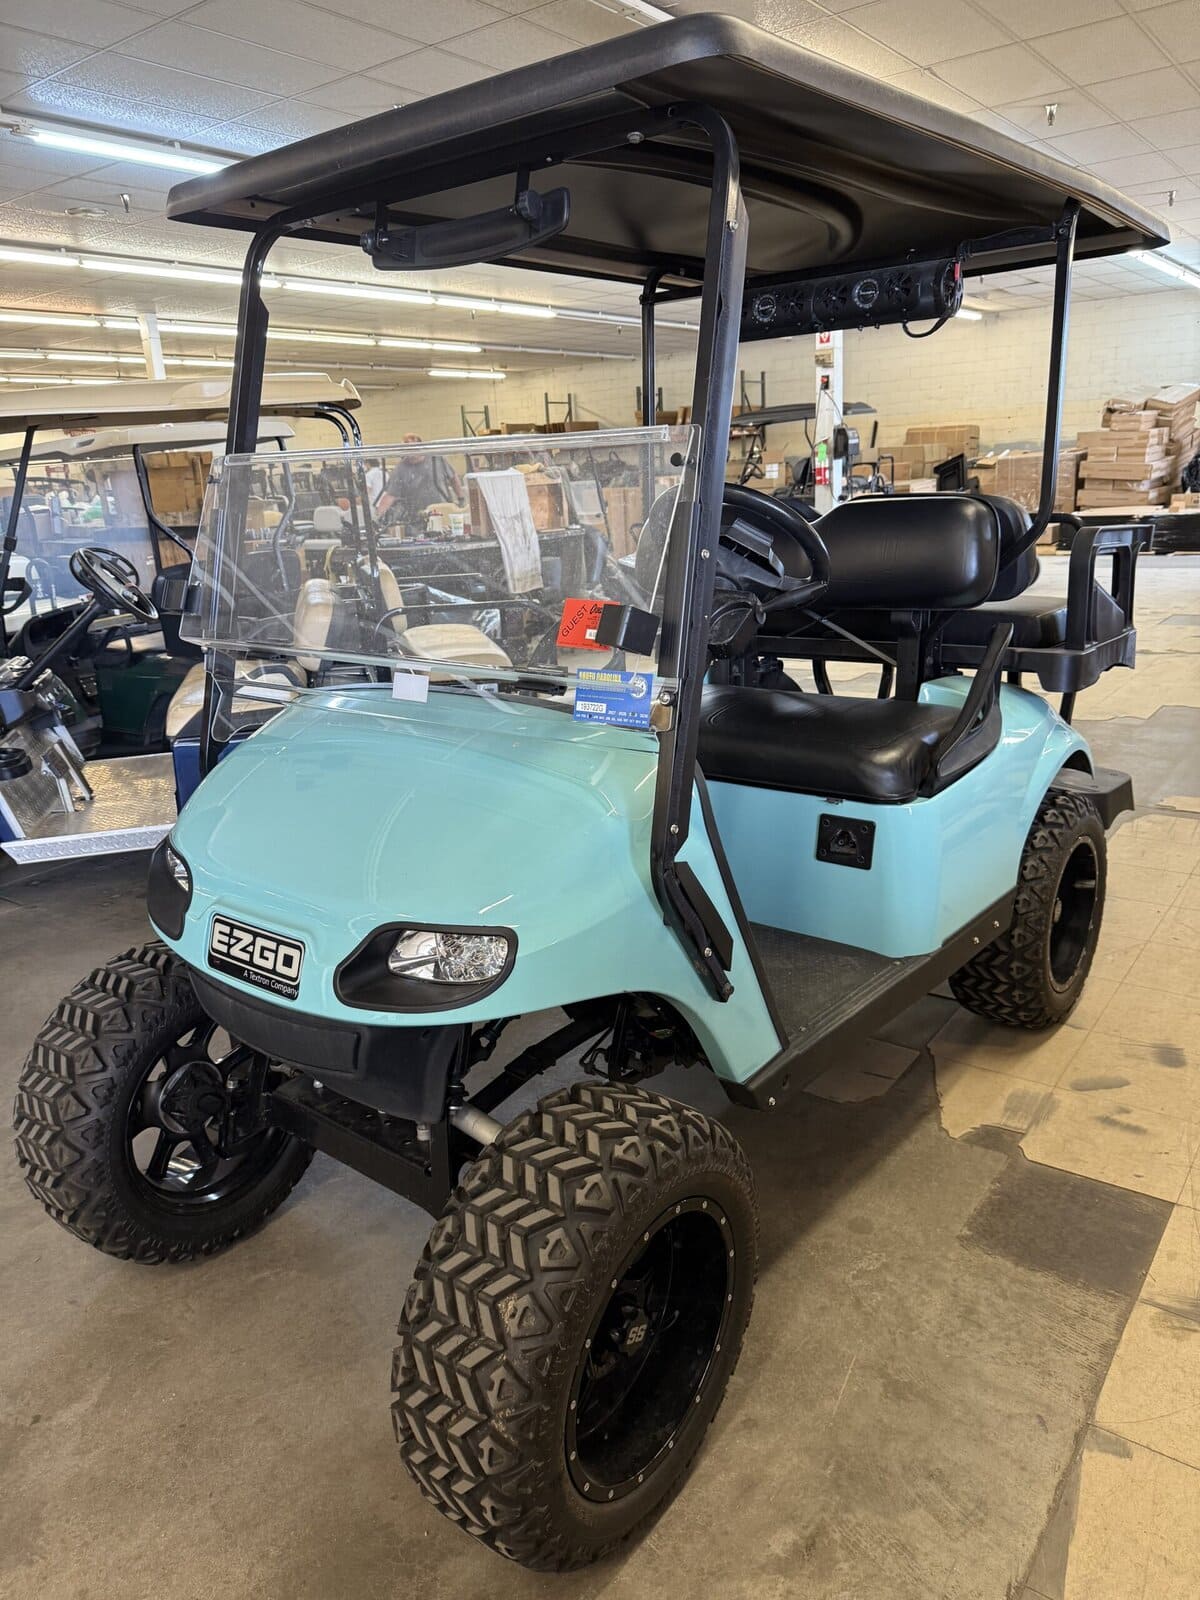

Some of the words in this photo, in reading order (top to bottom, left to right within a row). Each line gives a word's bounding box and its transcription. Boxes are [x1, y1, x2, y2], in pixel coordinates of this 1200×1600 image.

[561, 604, 589, 637] GUEST
[243, 969, 248, 977] A
[249, 971, 270, 986] Textron
[270, 980, 298, 997] Company
